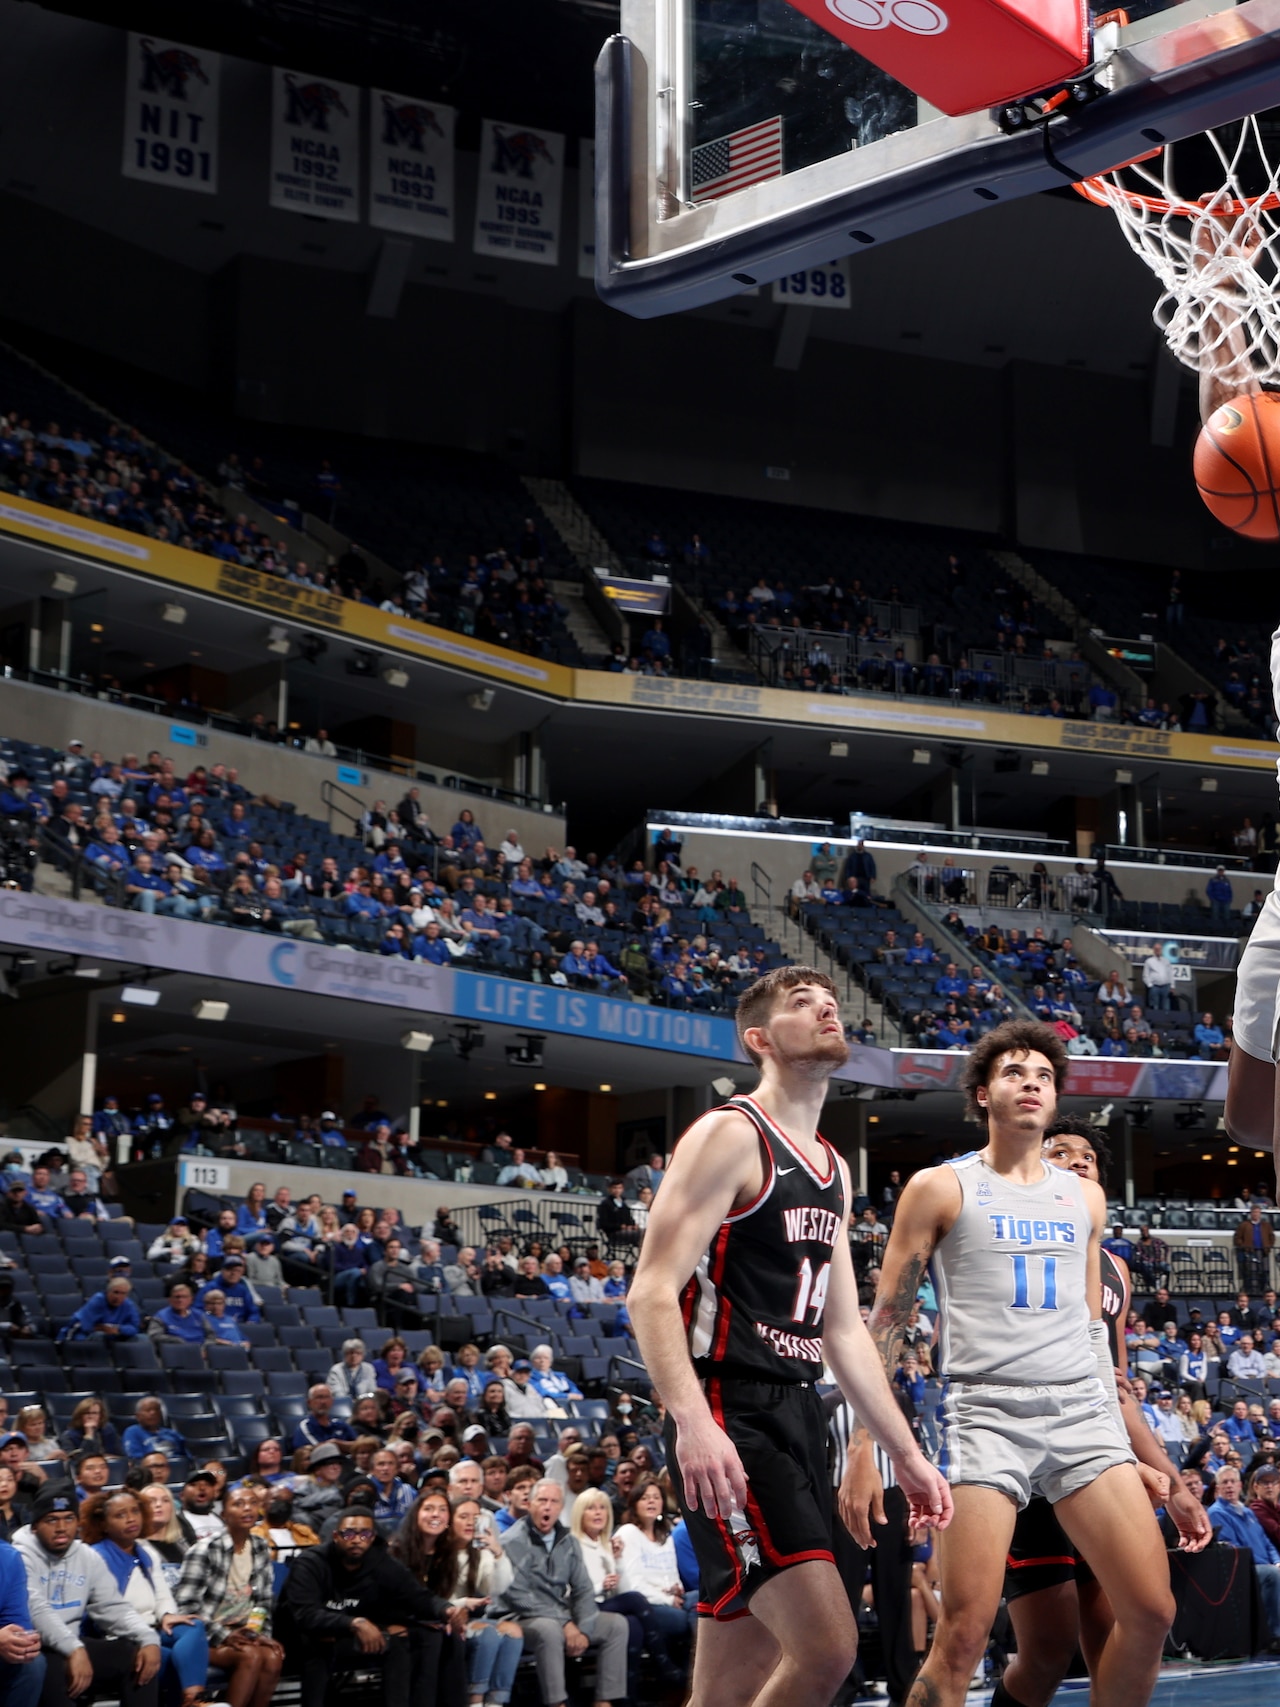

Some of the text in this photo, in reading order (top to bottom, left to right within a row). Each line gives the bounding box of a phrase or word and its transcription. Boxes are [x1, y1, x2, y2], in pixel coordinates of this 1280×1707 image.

[140, 102, 204, 144] NIT
[135, 138, 210, 181] 1991
[290, 135, 340, 163] NCAA
[293, 156, 339, 182] 1992
[387, 157, 436, 183] NCAA
[390, 177, 434, 202] 1993
[496, 184, 544, 208] NCAA
[497, 203, 541, 226] 1995
[780, 270, 846, 298] 1998
[1, 896, 155, 942] Campbell Clinic
[304, 950, 383, 982] Campbell
[388, 966, 431, 990] Clinic
[475, 979, 547, 1021] LIFE
[557, 994, 589, 1028] IS
[195, 1166, 219, 1185] 113
[783, 1207, 841, 1248] WESTER
[988, 1213, 1076, 1247] Tigers
[792, 1256, 832, 1327] 14
[1006, 1253, 1059, 1312] 11
